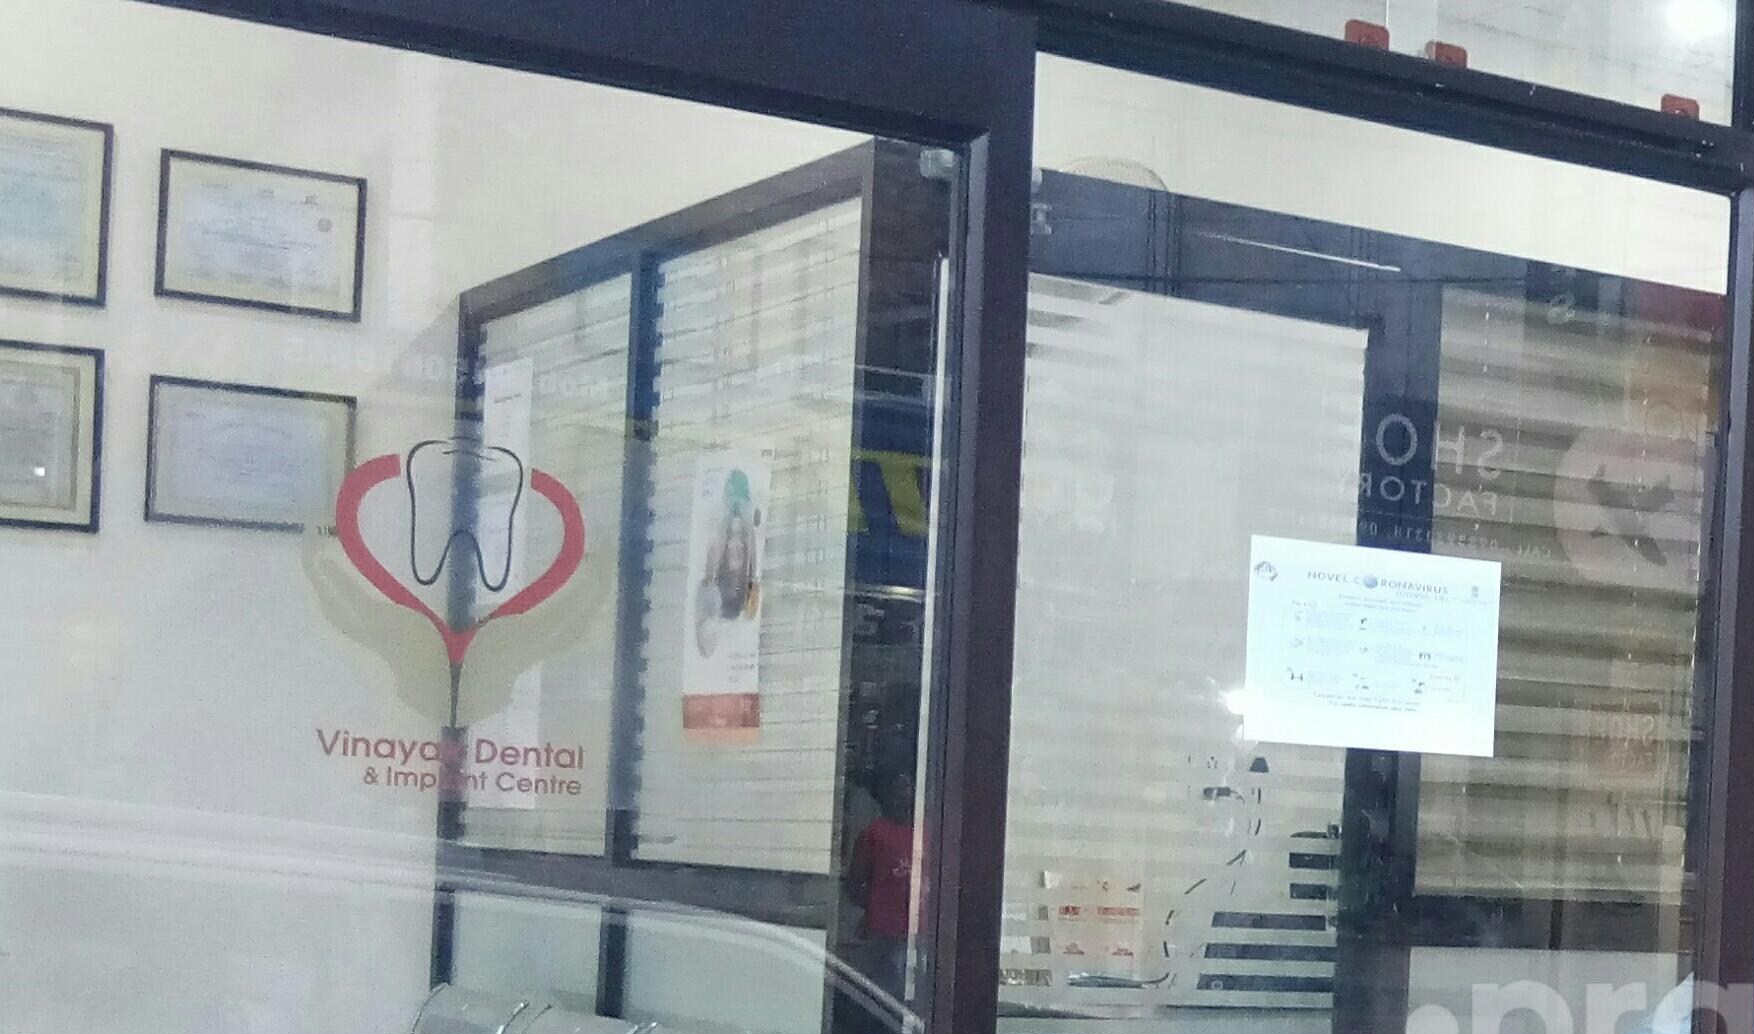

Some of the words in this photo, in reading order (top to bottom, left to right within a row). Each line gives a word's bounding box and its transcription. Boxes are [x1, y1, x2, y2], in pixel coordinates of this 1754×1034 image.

[1307, 570, 1349, 583] NOVEL
[474, 738, 585, 770] Dental
[362, 766, 378, 785] &
[386, 766, 488, 791] Impnt
[495, 771, 582, 795] Centre
